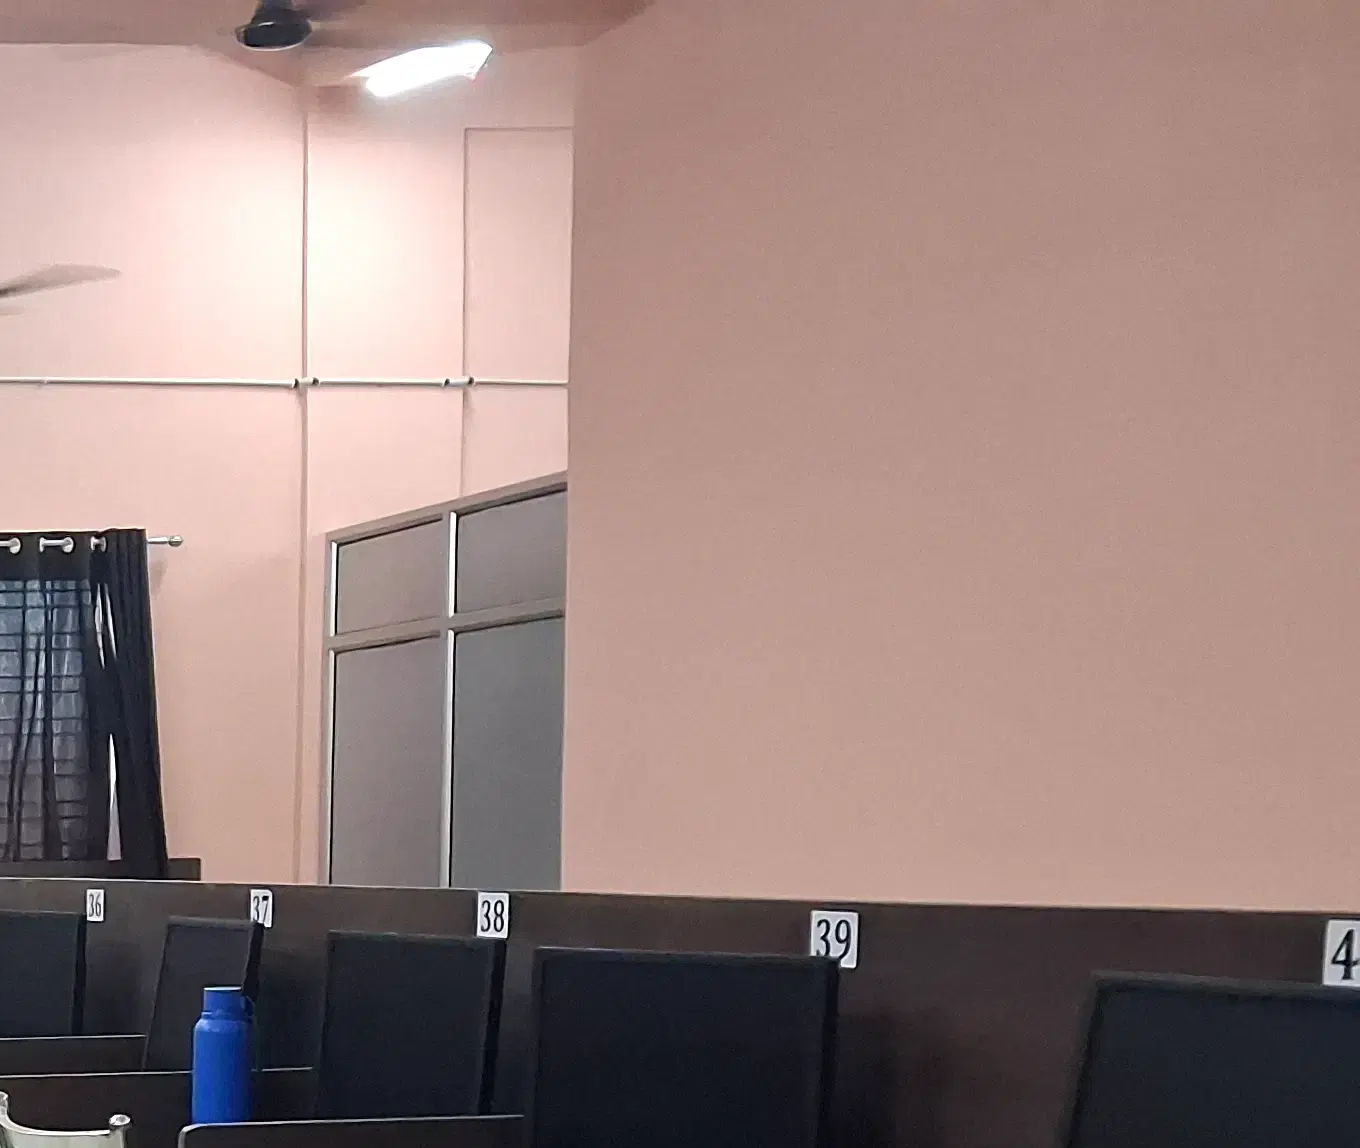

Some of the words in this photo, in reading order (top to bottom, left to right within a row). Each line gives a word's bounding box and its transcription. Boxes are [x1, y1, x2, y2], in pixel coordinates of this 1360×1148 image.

[88, 892, 102, 917] 36
[252, 895, 270, 924] 37
[480, 899, 505, 932] 38
[816, 918, 852, 960] 39
[1330, 928, 1360, 981] 4
